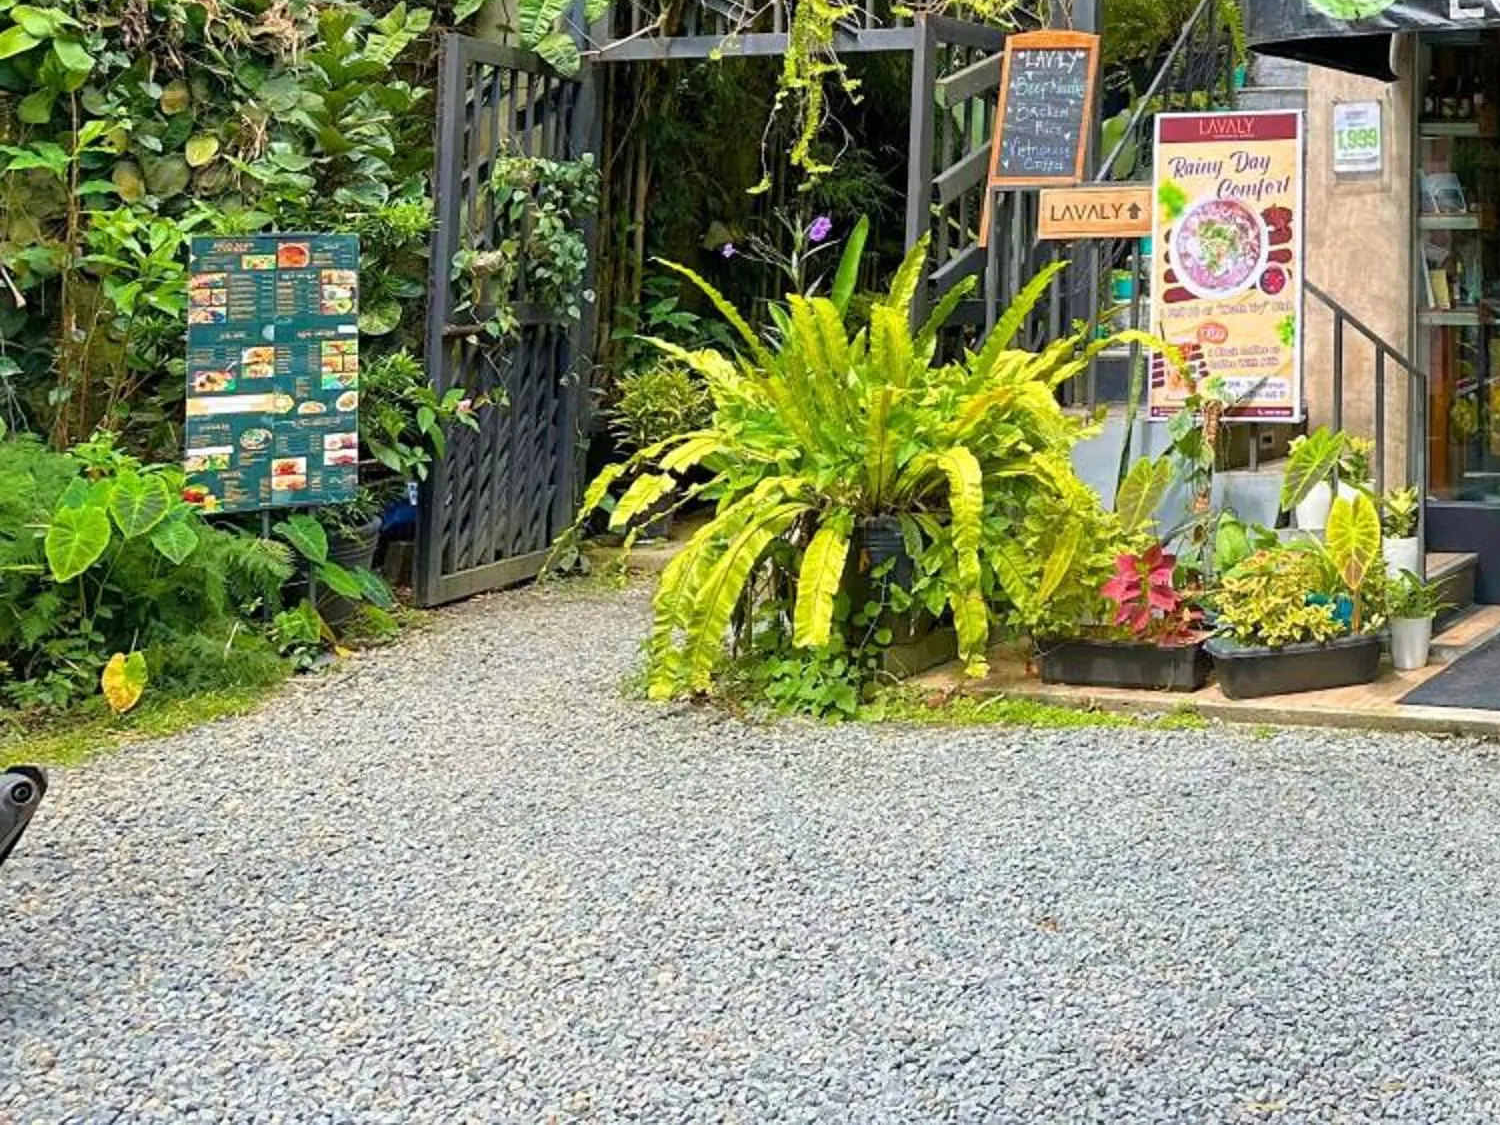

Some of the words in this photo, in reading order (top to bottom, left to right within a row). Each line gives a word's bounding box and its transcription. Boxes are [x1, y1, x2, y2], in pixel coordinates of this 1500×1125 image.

[1199, 118, 1256, 135] LAVALY
[1337, 127, 1378, 151] 1,999
[1168, 156, 1223, 179] Rainy
[1229, 150, 1271, 176] Day
[1217, 175, 1291, 201] Comfort
[1051, 202, 1125, 222] LAVALY
